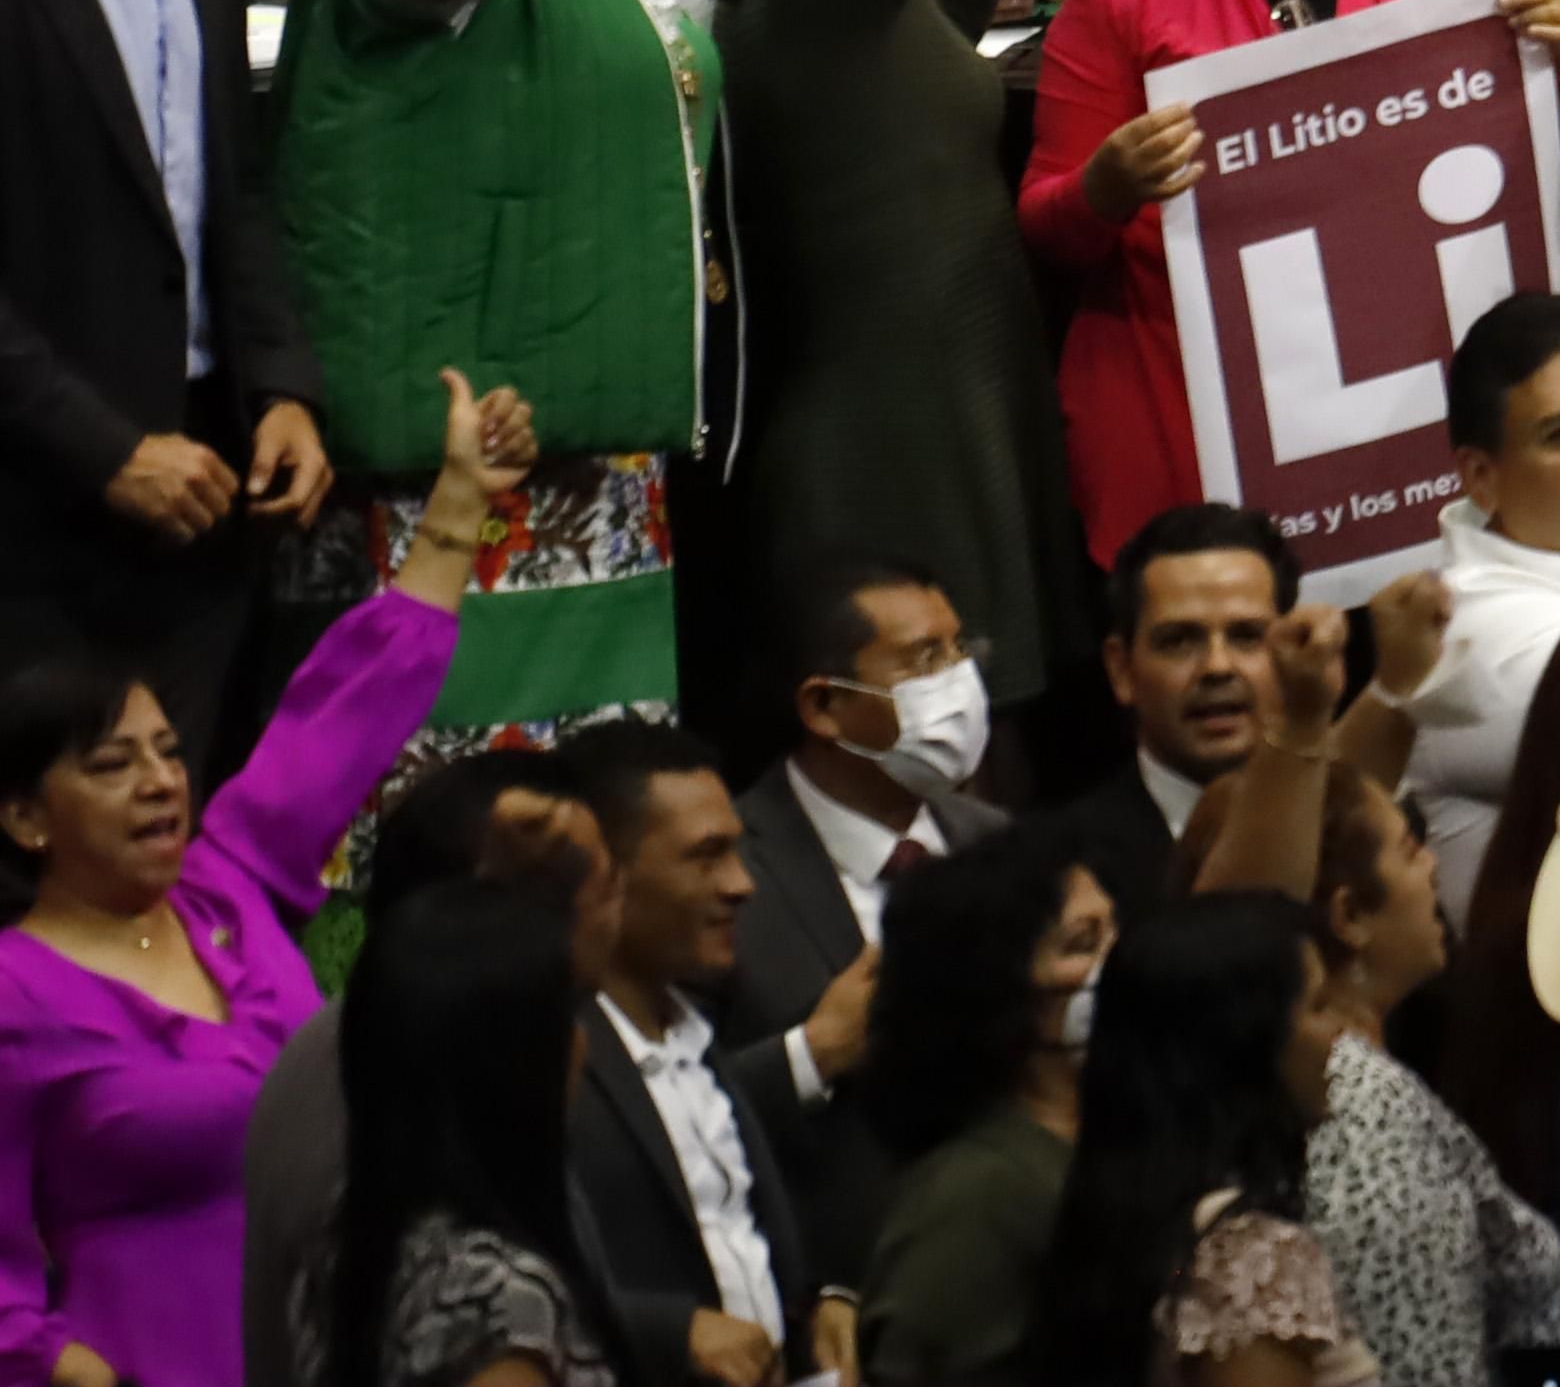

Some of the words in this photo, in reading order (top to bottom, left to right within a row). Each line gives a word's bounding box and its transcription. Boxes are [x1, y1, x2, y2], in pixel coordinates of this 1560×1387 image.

[1215, 128, 1259, 176] El
[1267, 102, 1367, 160] Litio
[1375, 87, 1430, 126] es
[1437, 68, 1495, 110] de
[1238, 143, 1516, 467] Li
[1322, 503, 1344, 535] y
[1349, 490, 1399, 522] los
